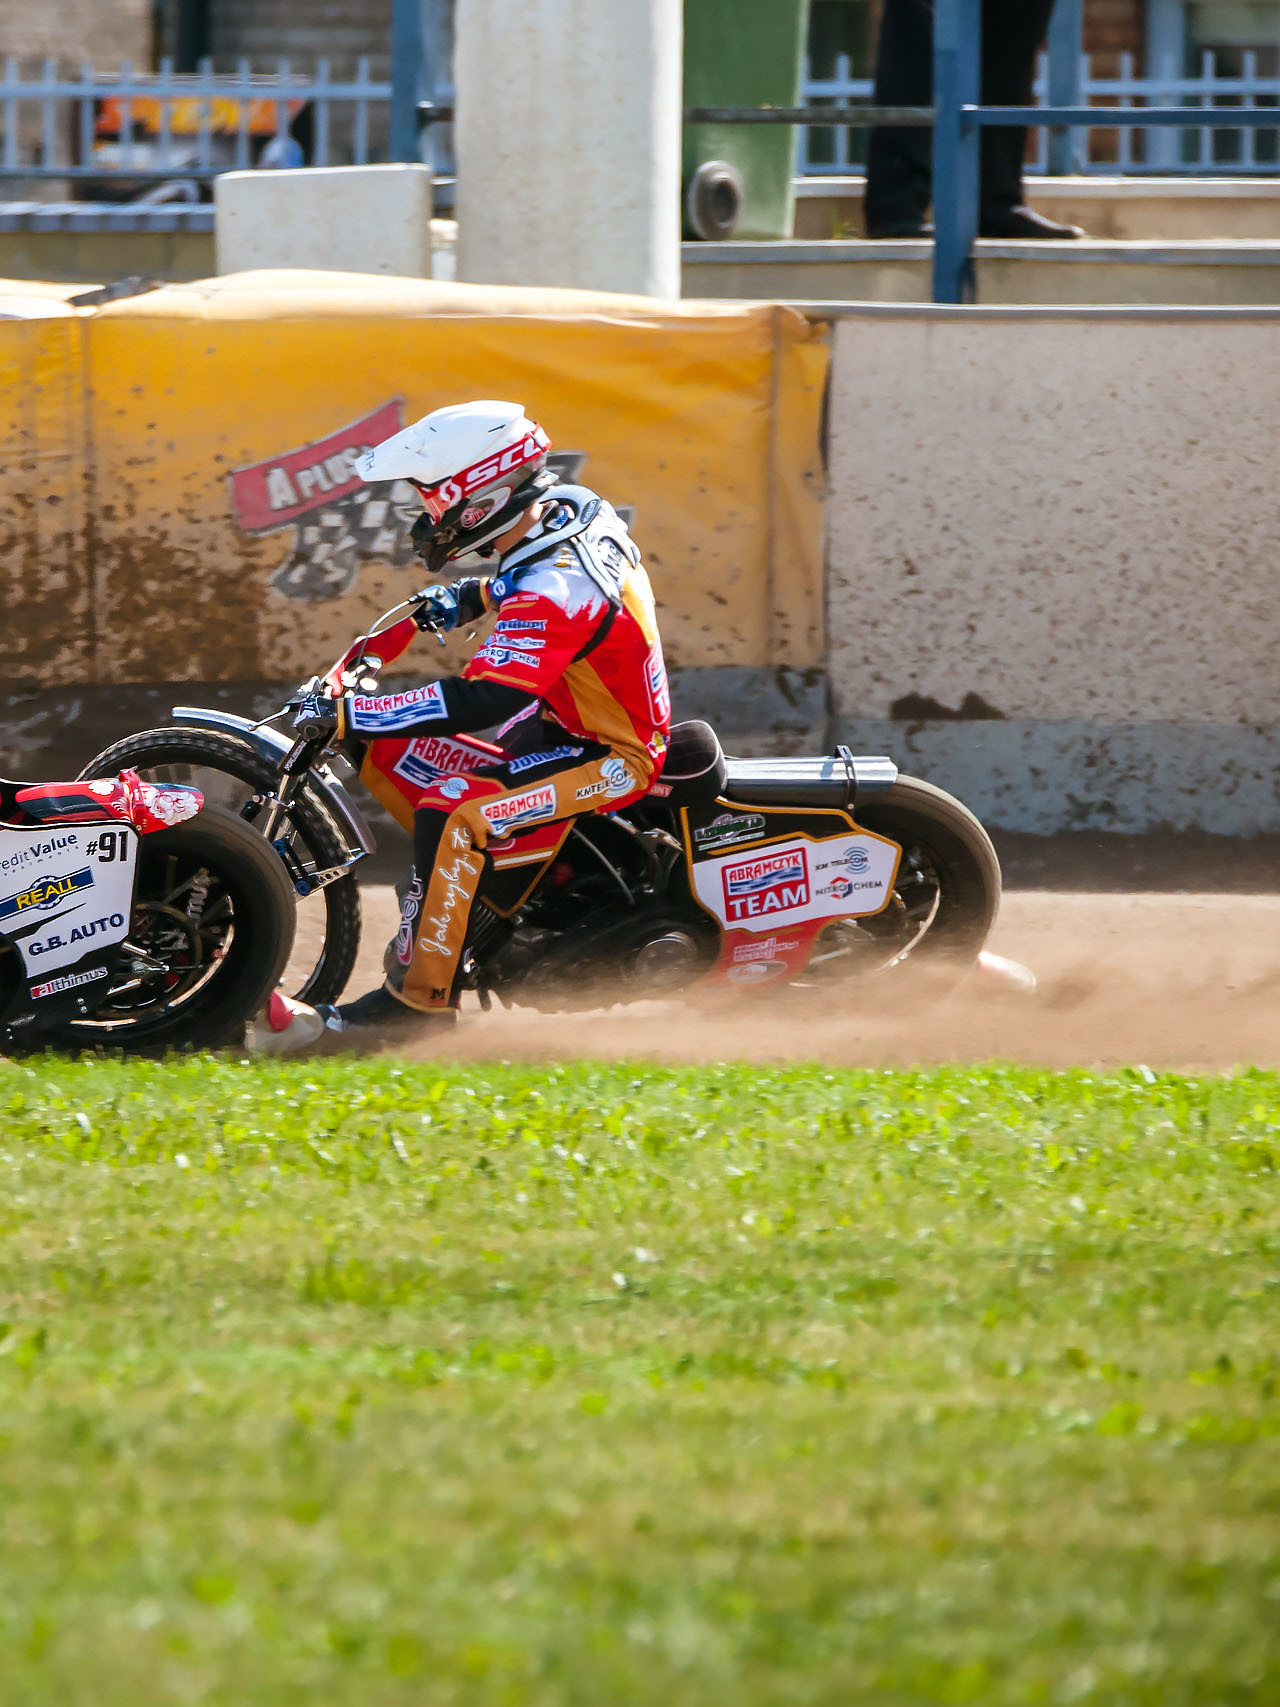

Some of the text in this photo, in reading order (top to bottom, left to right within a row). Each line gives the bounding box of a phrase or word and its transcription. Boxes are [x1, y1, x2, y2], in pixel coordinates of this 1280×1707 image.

[266, 466, 299, 512] A
[354, 685, 439, 712] ABRAMCZYK
[30, 834, 78, 858] Value
[85, 830, 129, 863] #91
[729, 854, 801, 882] ABRAMCZYK
[728, 883, 807, 918] TEAM
[28, 913, 125, 956] G.B. AUTO
